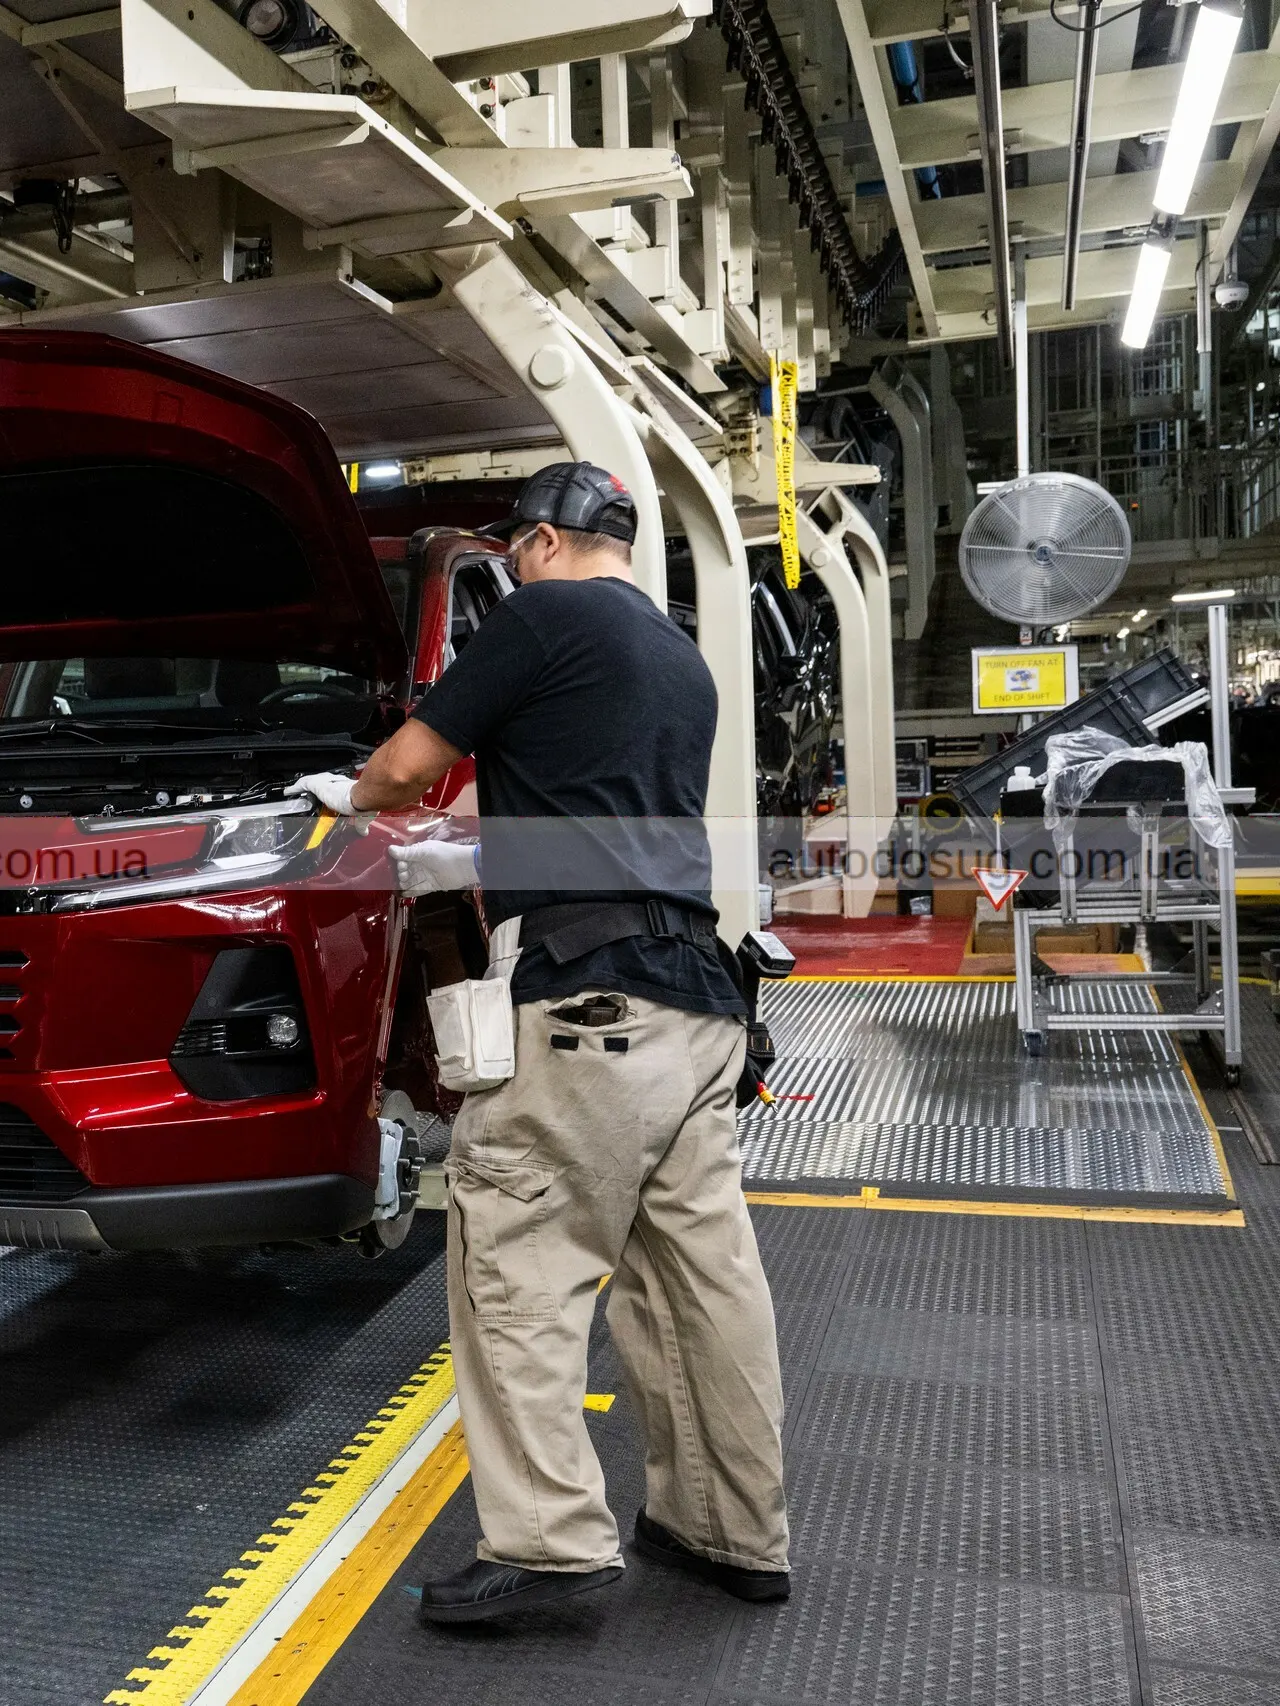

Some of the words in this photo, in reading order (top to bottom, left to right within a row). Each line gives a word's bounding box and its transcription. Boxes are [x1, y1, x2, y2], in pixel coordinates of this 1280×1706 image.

[985, 660, 1007, 669] TURN
[1010, 660, 1026, 668] OFF
[1028, 658, 1044, 667] FAN
[994, 694, 1011, 702] END
[1027, 692, 1050, 700] SHIFT
